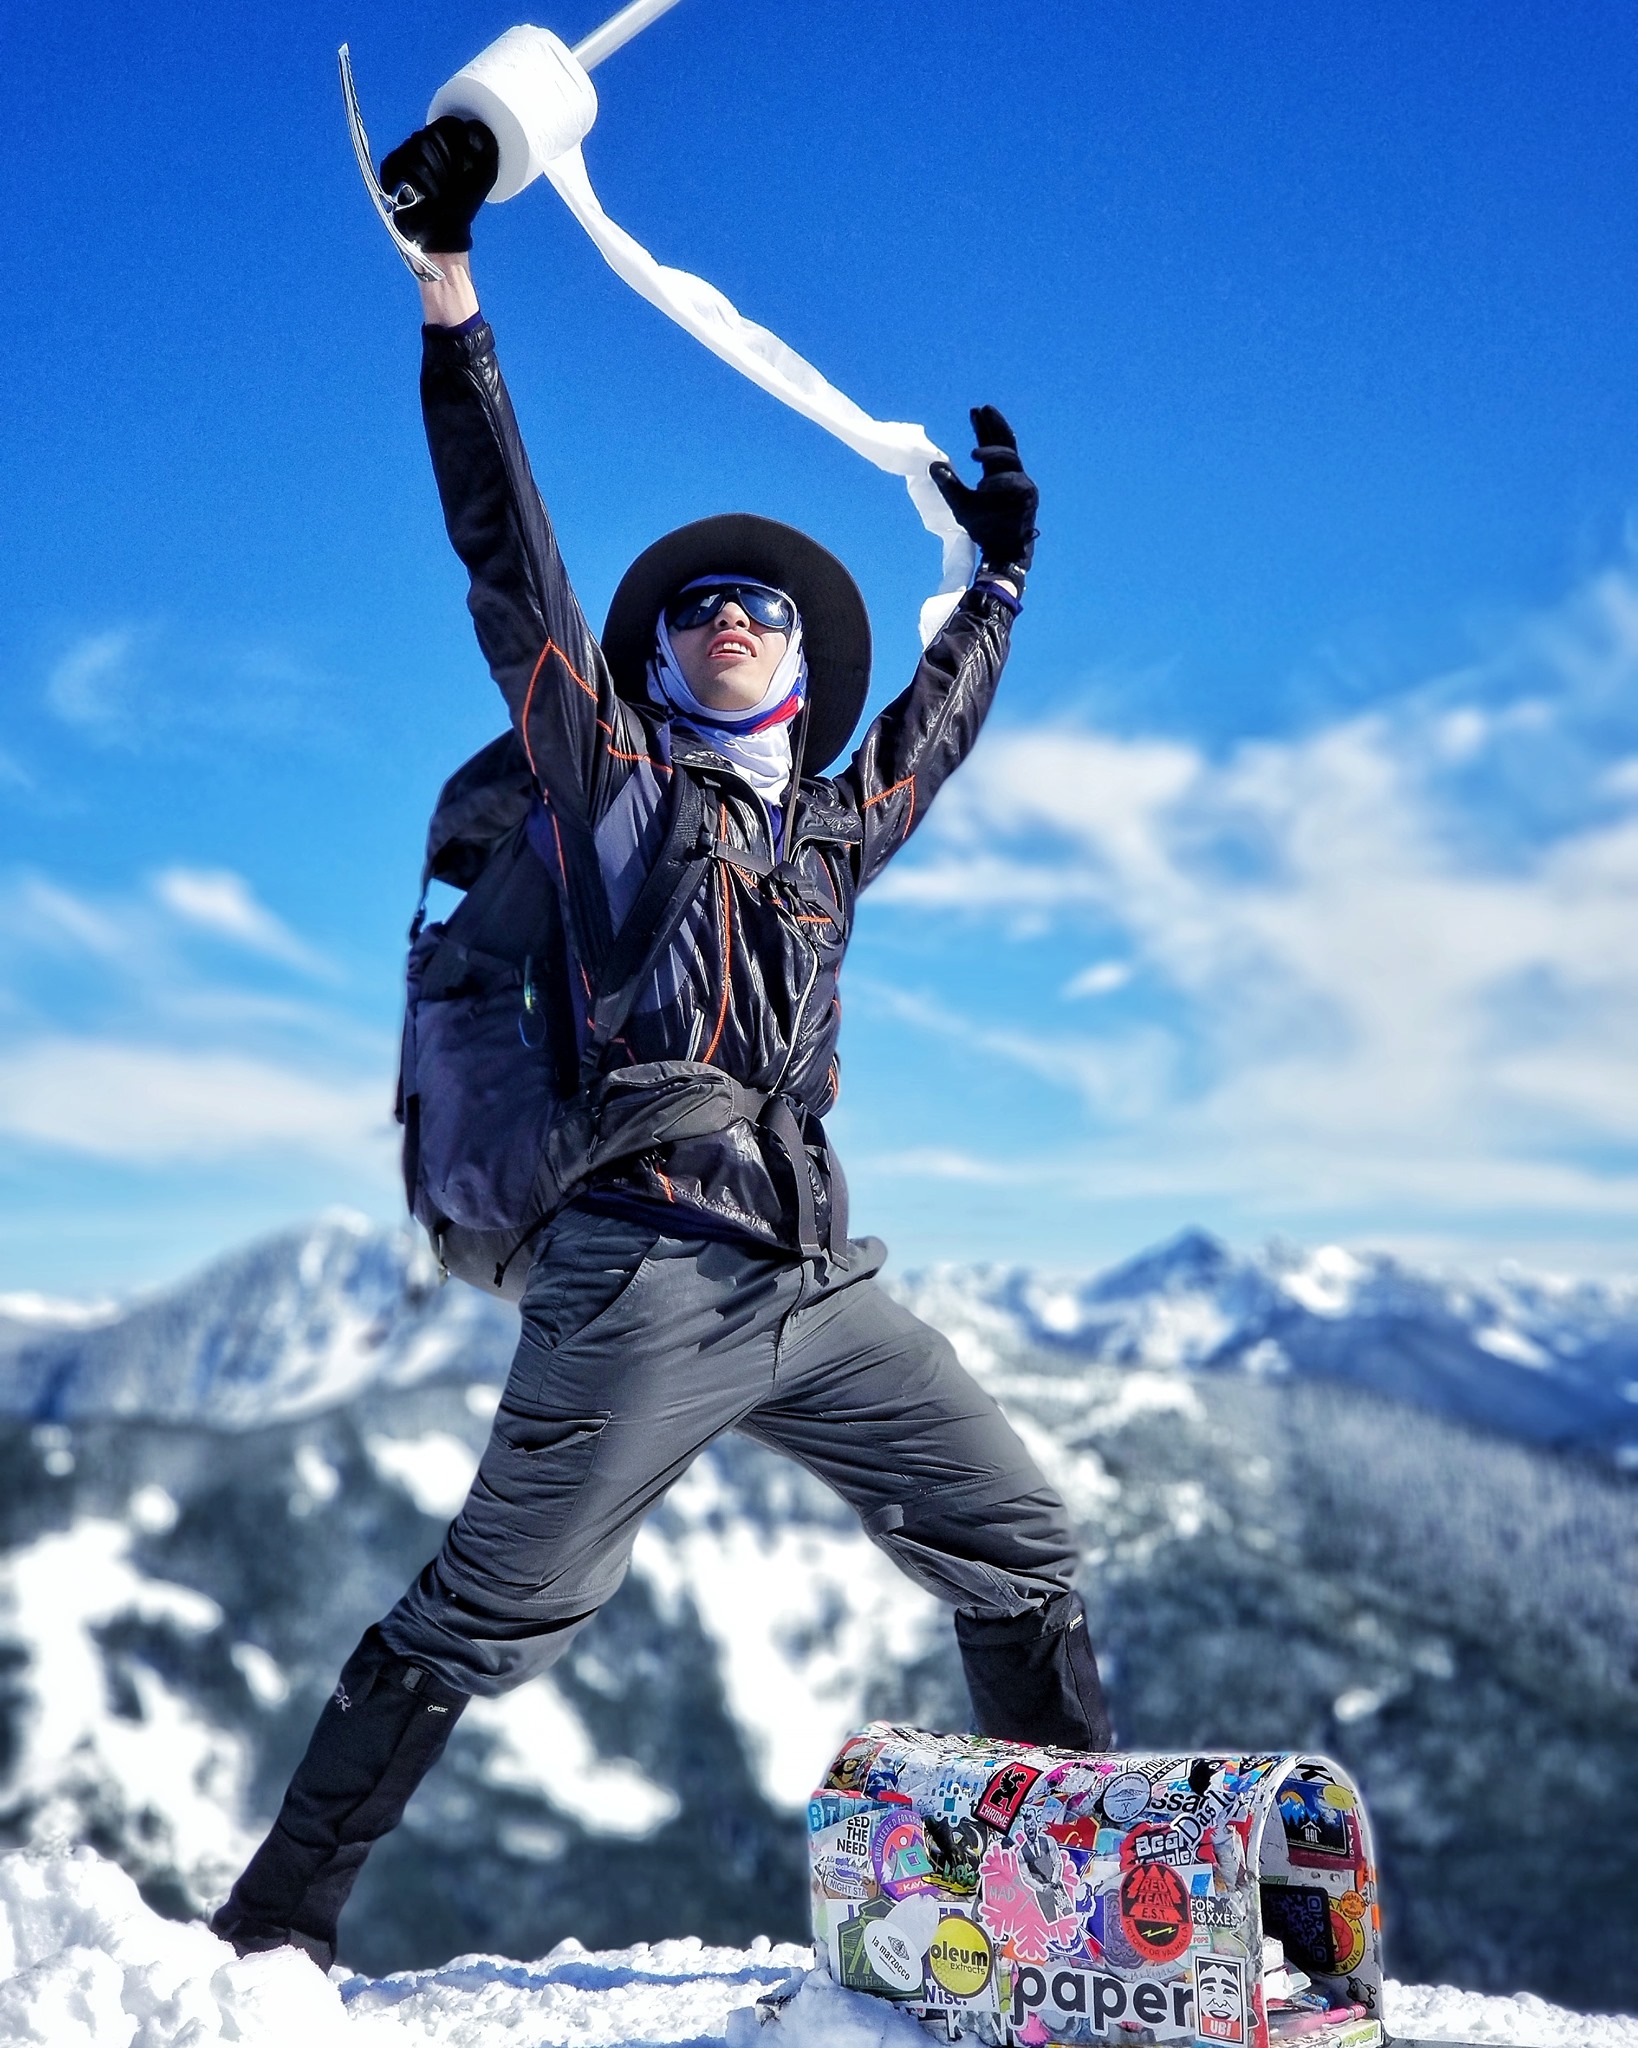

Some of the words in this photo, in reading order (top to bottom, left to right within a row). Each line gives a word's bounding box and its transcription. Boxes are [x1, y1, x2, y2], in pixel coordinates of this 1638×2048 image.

[979, 1803, 1011, 1829] CHROME
[846, 1826, 868, 1843] THE
[874, 1818, 898, 1862] ENGINEERED
[837, 1838, 868, 1857] NEED
[829, 1879, 851, 1894] NIGHT
[989, 1885, 1016, 1902] MAD
[1140, 1879, 1169, 1893] RED
[1138, 1892, 1175, 1908] TEAM
[1191, 1899, 1215, 1912] FOR
[1141, 1907, 1169, 1921] E.S.T.
[1191, 1911, 1239, 1926] FOXXES
[1125, 1920, 1149, 1951] VICTORY
[1161, 1925, 1189, 1958] VALHALLA
[871, 1935, 880, 1948] la
[879, 1945, 911, 1981] marzocco
[930, 1940, 988, 1967] oleum
[950, 1963, 986, 1975] extracts
[1013, 1966, 1194, 2029] paper
[1209, 2019, 1232, 2037] UBI
